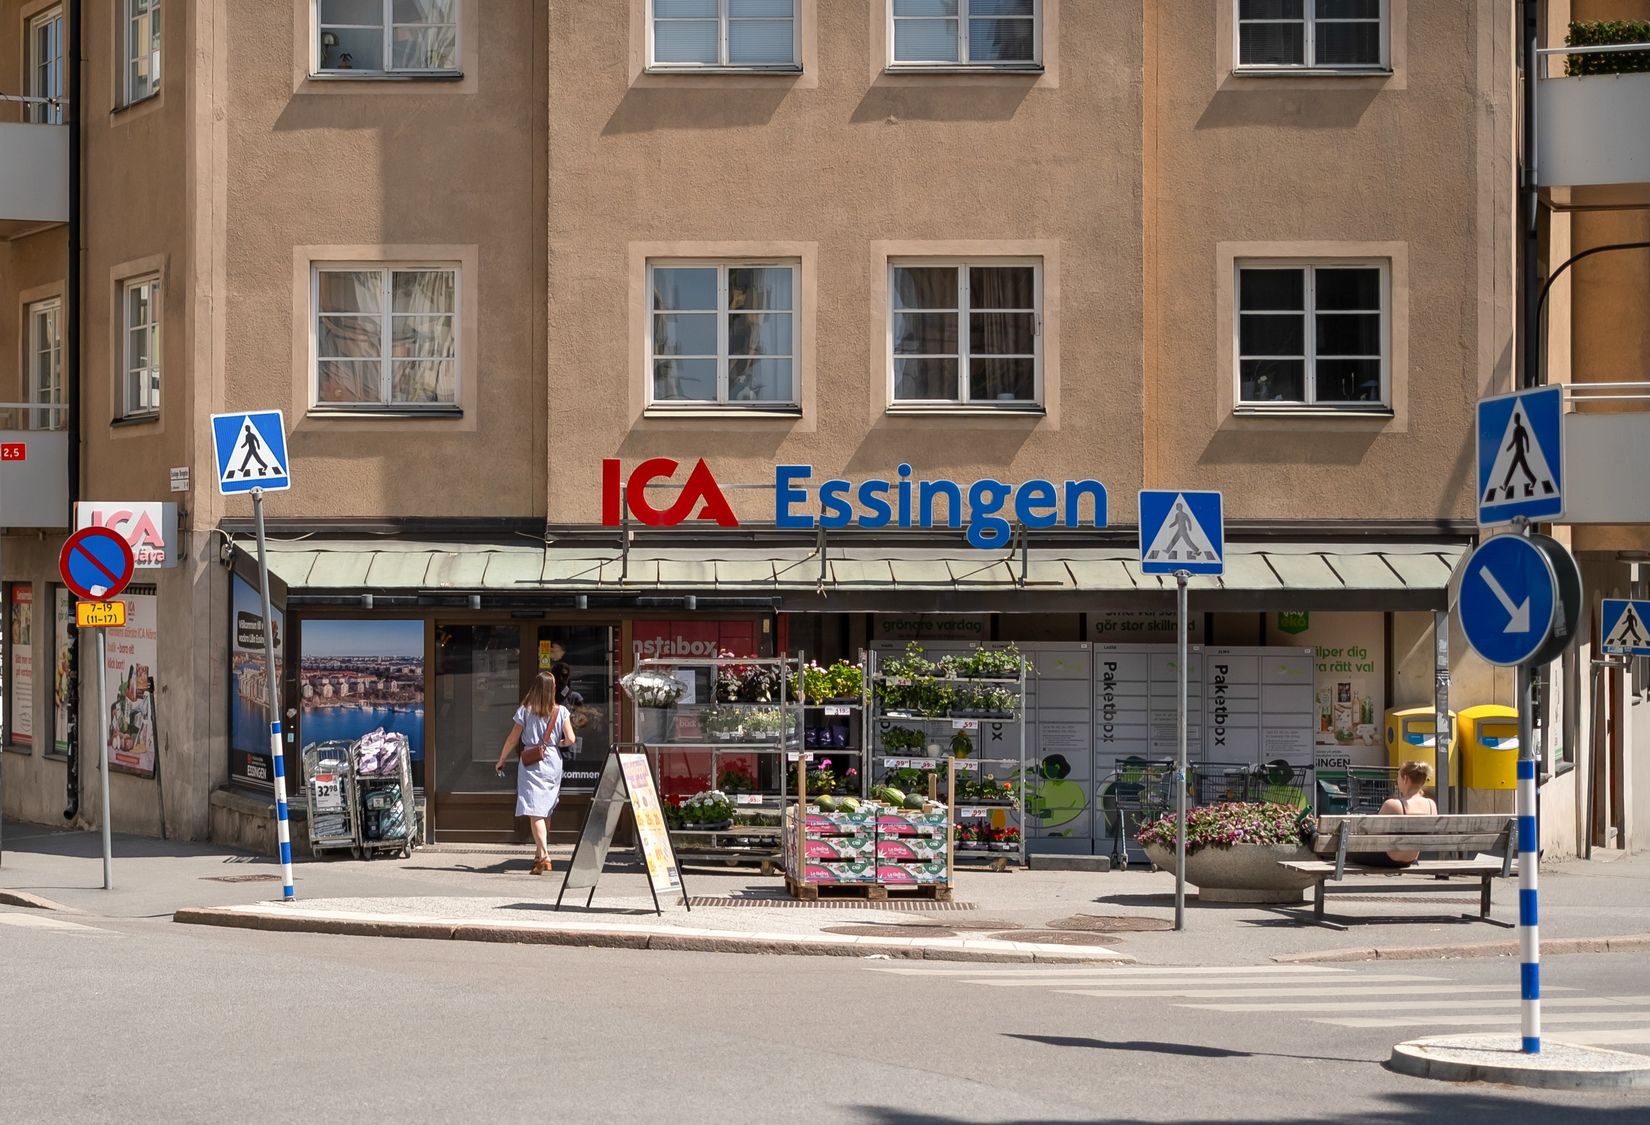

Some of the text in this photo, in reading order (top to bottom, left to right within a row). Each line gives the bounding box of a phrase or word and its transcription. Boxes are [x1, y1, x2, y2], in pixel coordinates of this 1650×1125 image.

[3, 448, 20, 458] 2,5
[602, 457, 1108, 550] ICA Essingen
[134, 549, 165, 562] ära
[91, 603, 112, 613] 7-19
[86, 614, 117, 624] (11-17)
[936, 619, 982, 633] vardag
[1096, 620, 1195, 634] gör stor skillnd
[633, 636, 717, 655] nstabox
[1347, 646, 1367, 659] dig
[1330, 661, 1352, 672] rätt
[1355, 661, 1374, 672] val
[1104, 662, 1117, 743] Paketbox
[1215, 665, 1228, 746] Paketbox
[1316, 758, 1351, 768] INGEN
[562, 770, 600, 779] kommen
